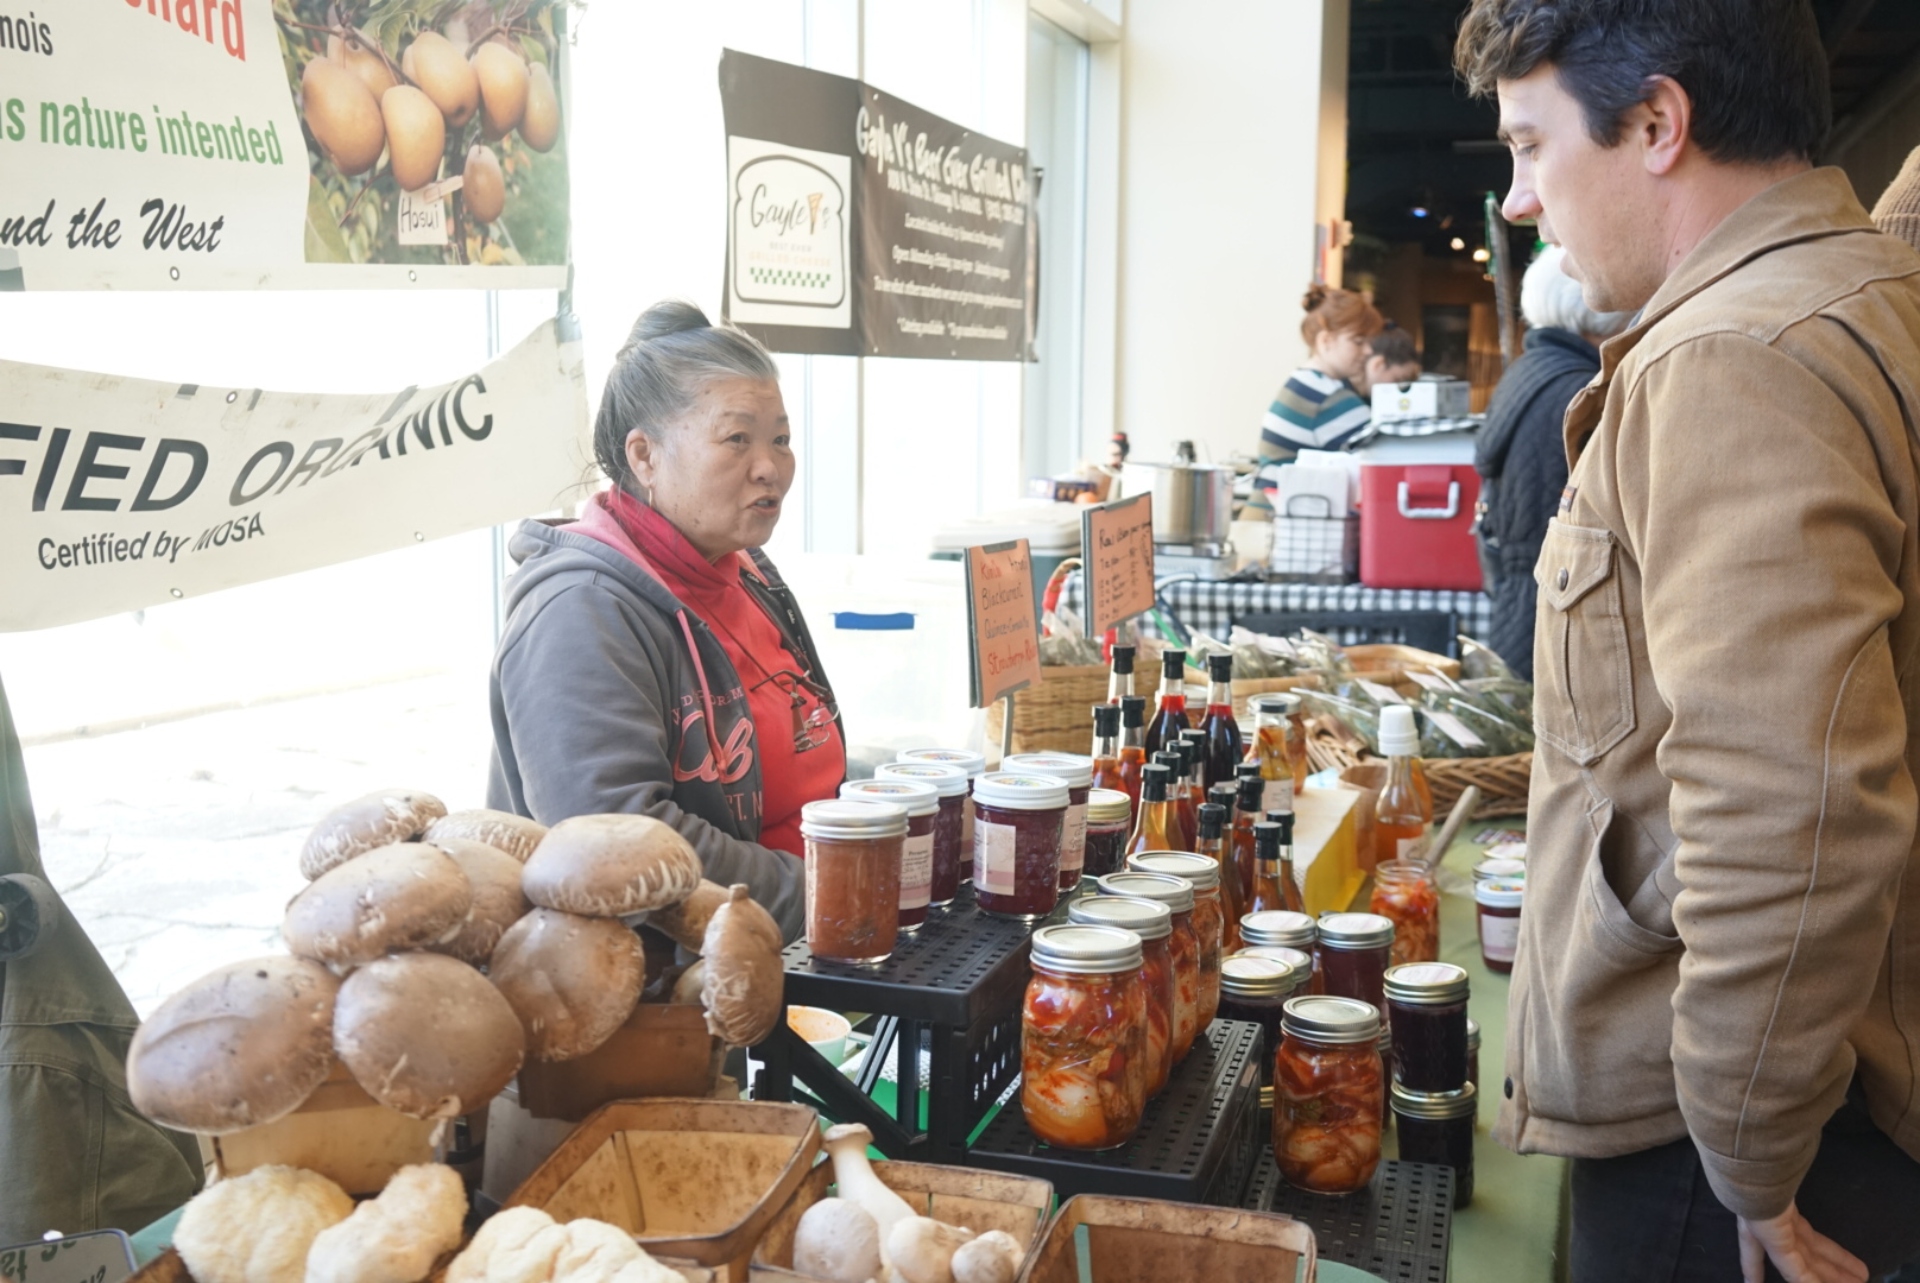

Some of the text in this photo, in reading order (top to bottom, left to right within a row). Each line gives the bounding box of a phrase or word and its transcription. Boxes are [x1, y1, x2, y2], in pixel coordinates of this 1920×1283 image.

[0, 97, 284, 165] s nature intended
[66, 197, 122, 249] the
[140, 198, 225, 252] West
[401, 196, 439, 233] Hosui
[229, 373, 494, 507] ORGANIC
[38, 511, 266, 570] Certified by MOSA
